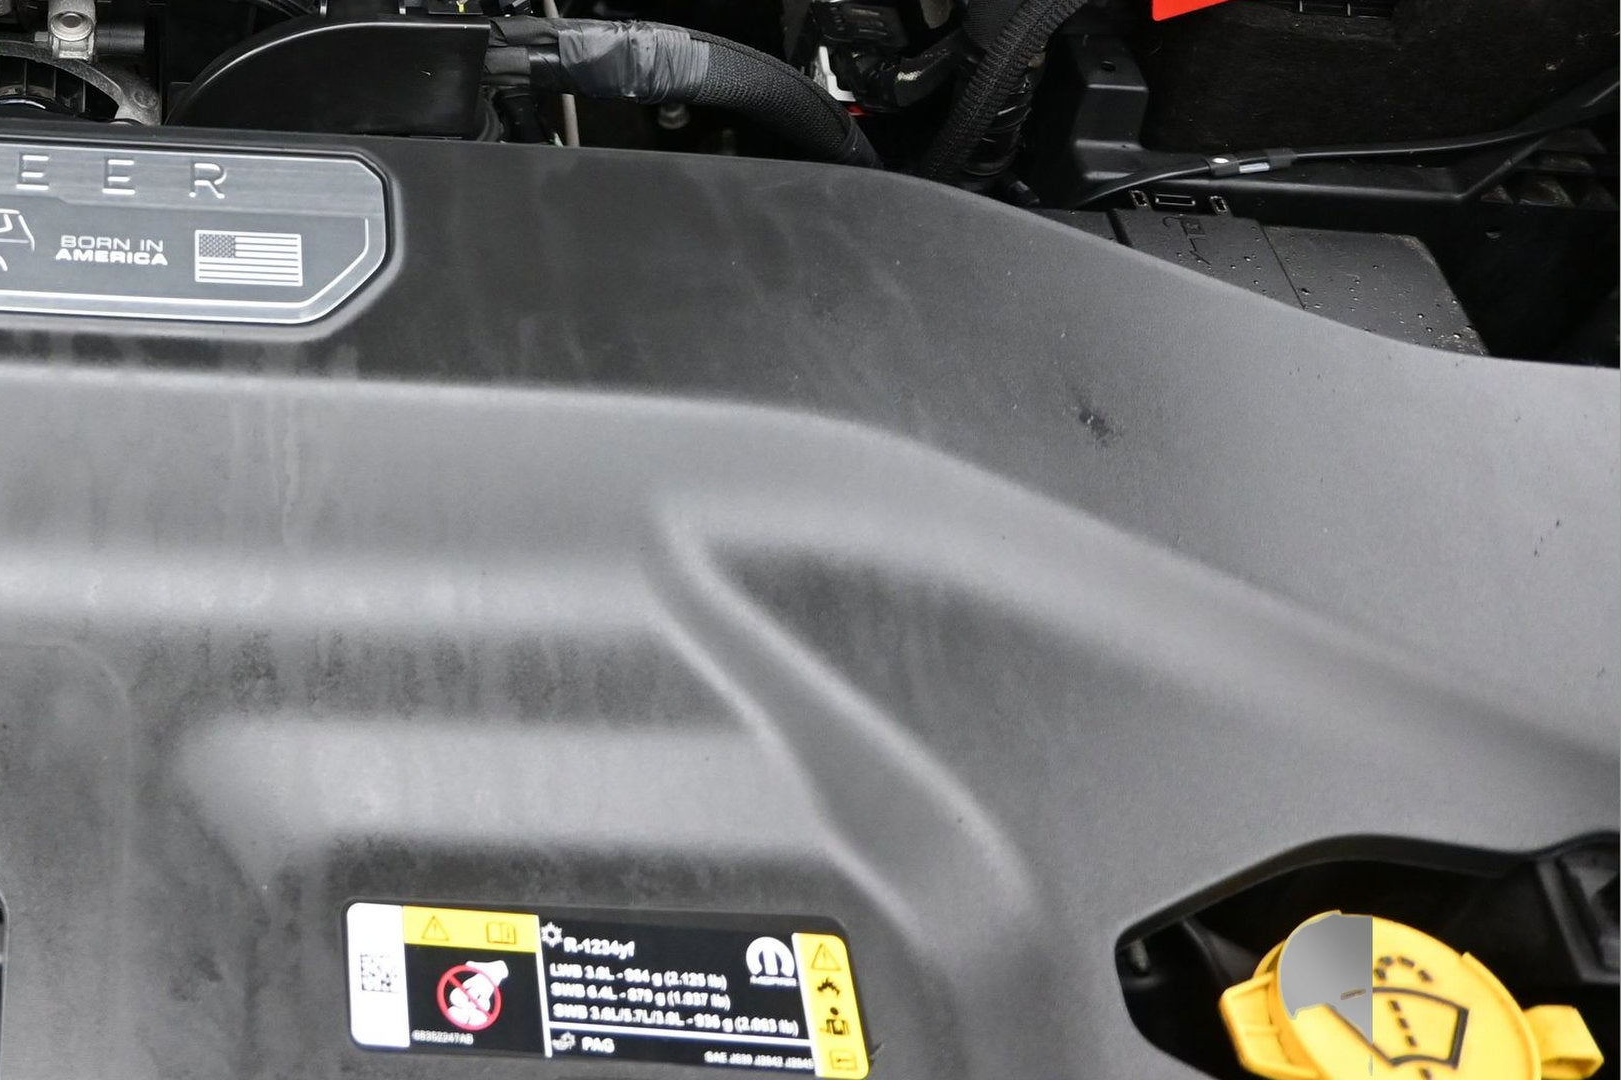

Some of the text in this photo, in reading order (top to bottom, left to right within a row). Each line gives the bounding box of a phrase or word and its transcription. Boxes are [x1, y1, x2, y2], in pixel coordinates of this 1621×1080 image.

[60, 234, 163, 252] BORN IN
[55, 248, 168, 266] AMERICA
[581, 1036, 615, 1054] PAG
